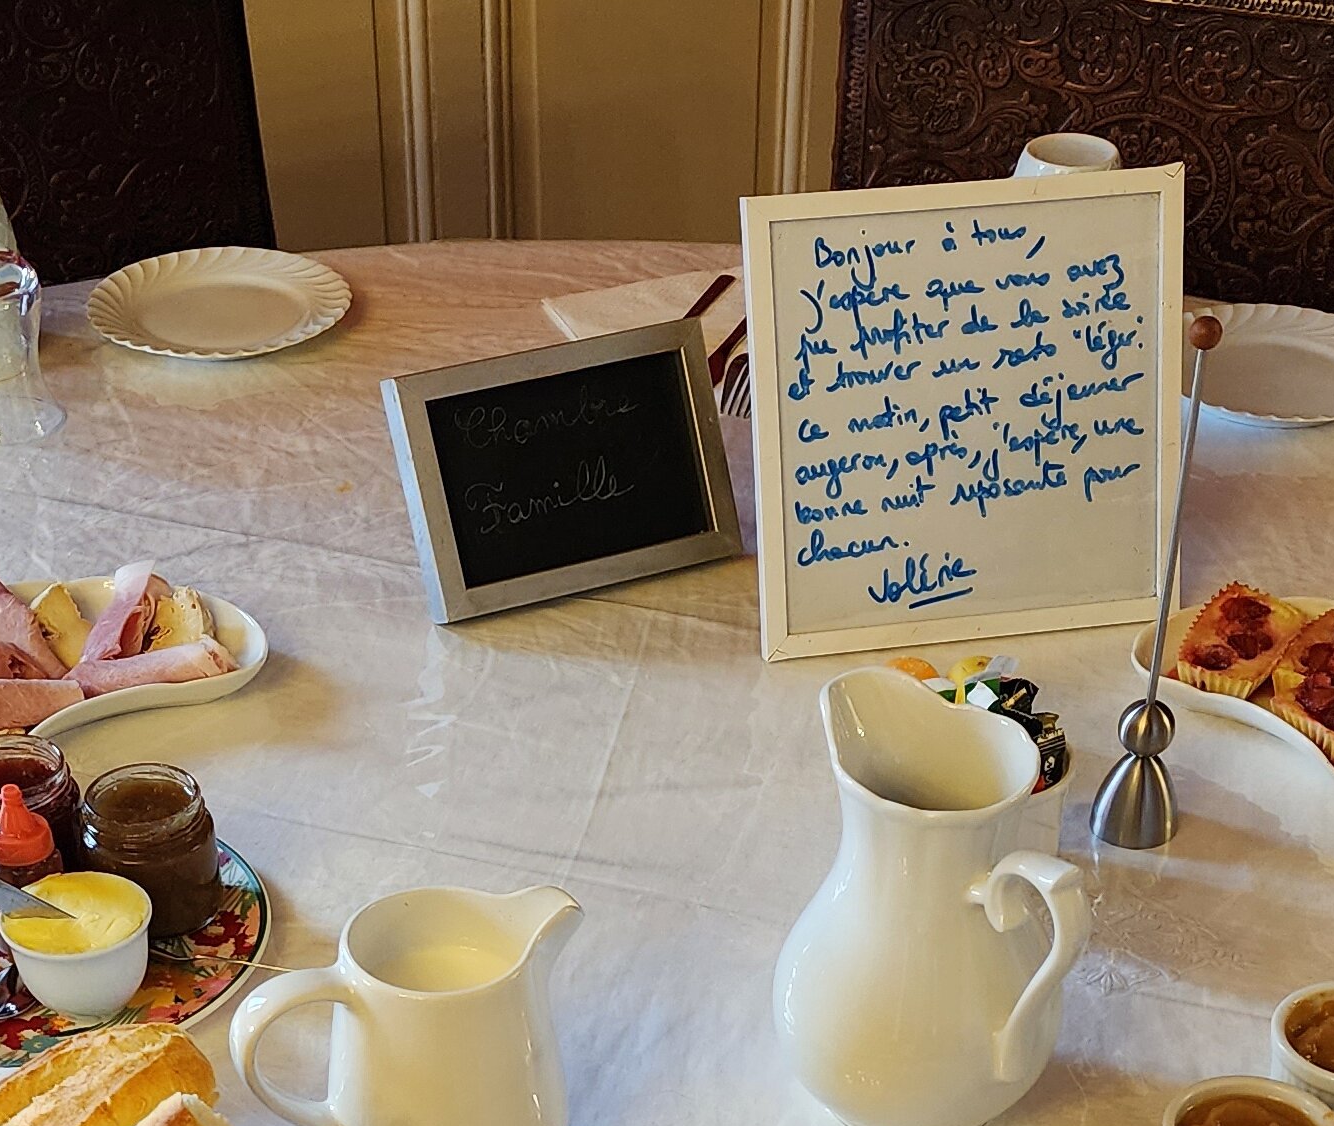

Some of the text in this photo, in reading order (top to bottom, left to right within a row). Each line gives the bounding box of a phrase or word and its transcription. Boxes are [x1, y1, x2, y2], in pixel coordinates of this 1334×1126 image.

[815, 219, 1046, 291] Bonjour à tous,
[925, 278, 985, 311] que
[995, 272, 1050, 290] vous
[1066, 253, 1125, 291] avez
[787, 368, 815, 400] et
[826, 360, 922, 393] trouver
[932, 357, 981, 378] un
[992, 331, 1057, 369] resto
[794, 333, 837, 372] pu
[850, 308, 950, 360] profiter
[961, 304, 998, 334] de
[1010, 298, 1050, 328] la
[454, 383, 641, 448] Chambre
[848, 396, 930, 433] matin,
[938, 388, 1000, 441] petit
[1019, 372, 1145, 431] déjeuner
[795, 452, 899, 499] augeron,
[1093, 416, 1144, 437] une
[464, 455, 635, 534] Famille
[794, 460, 1141, 525] bonne nuit reposante pour
[797, 528, 910, 567] chacun.
[867, 552, 978, 604] Valérie
